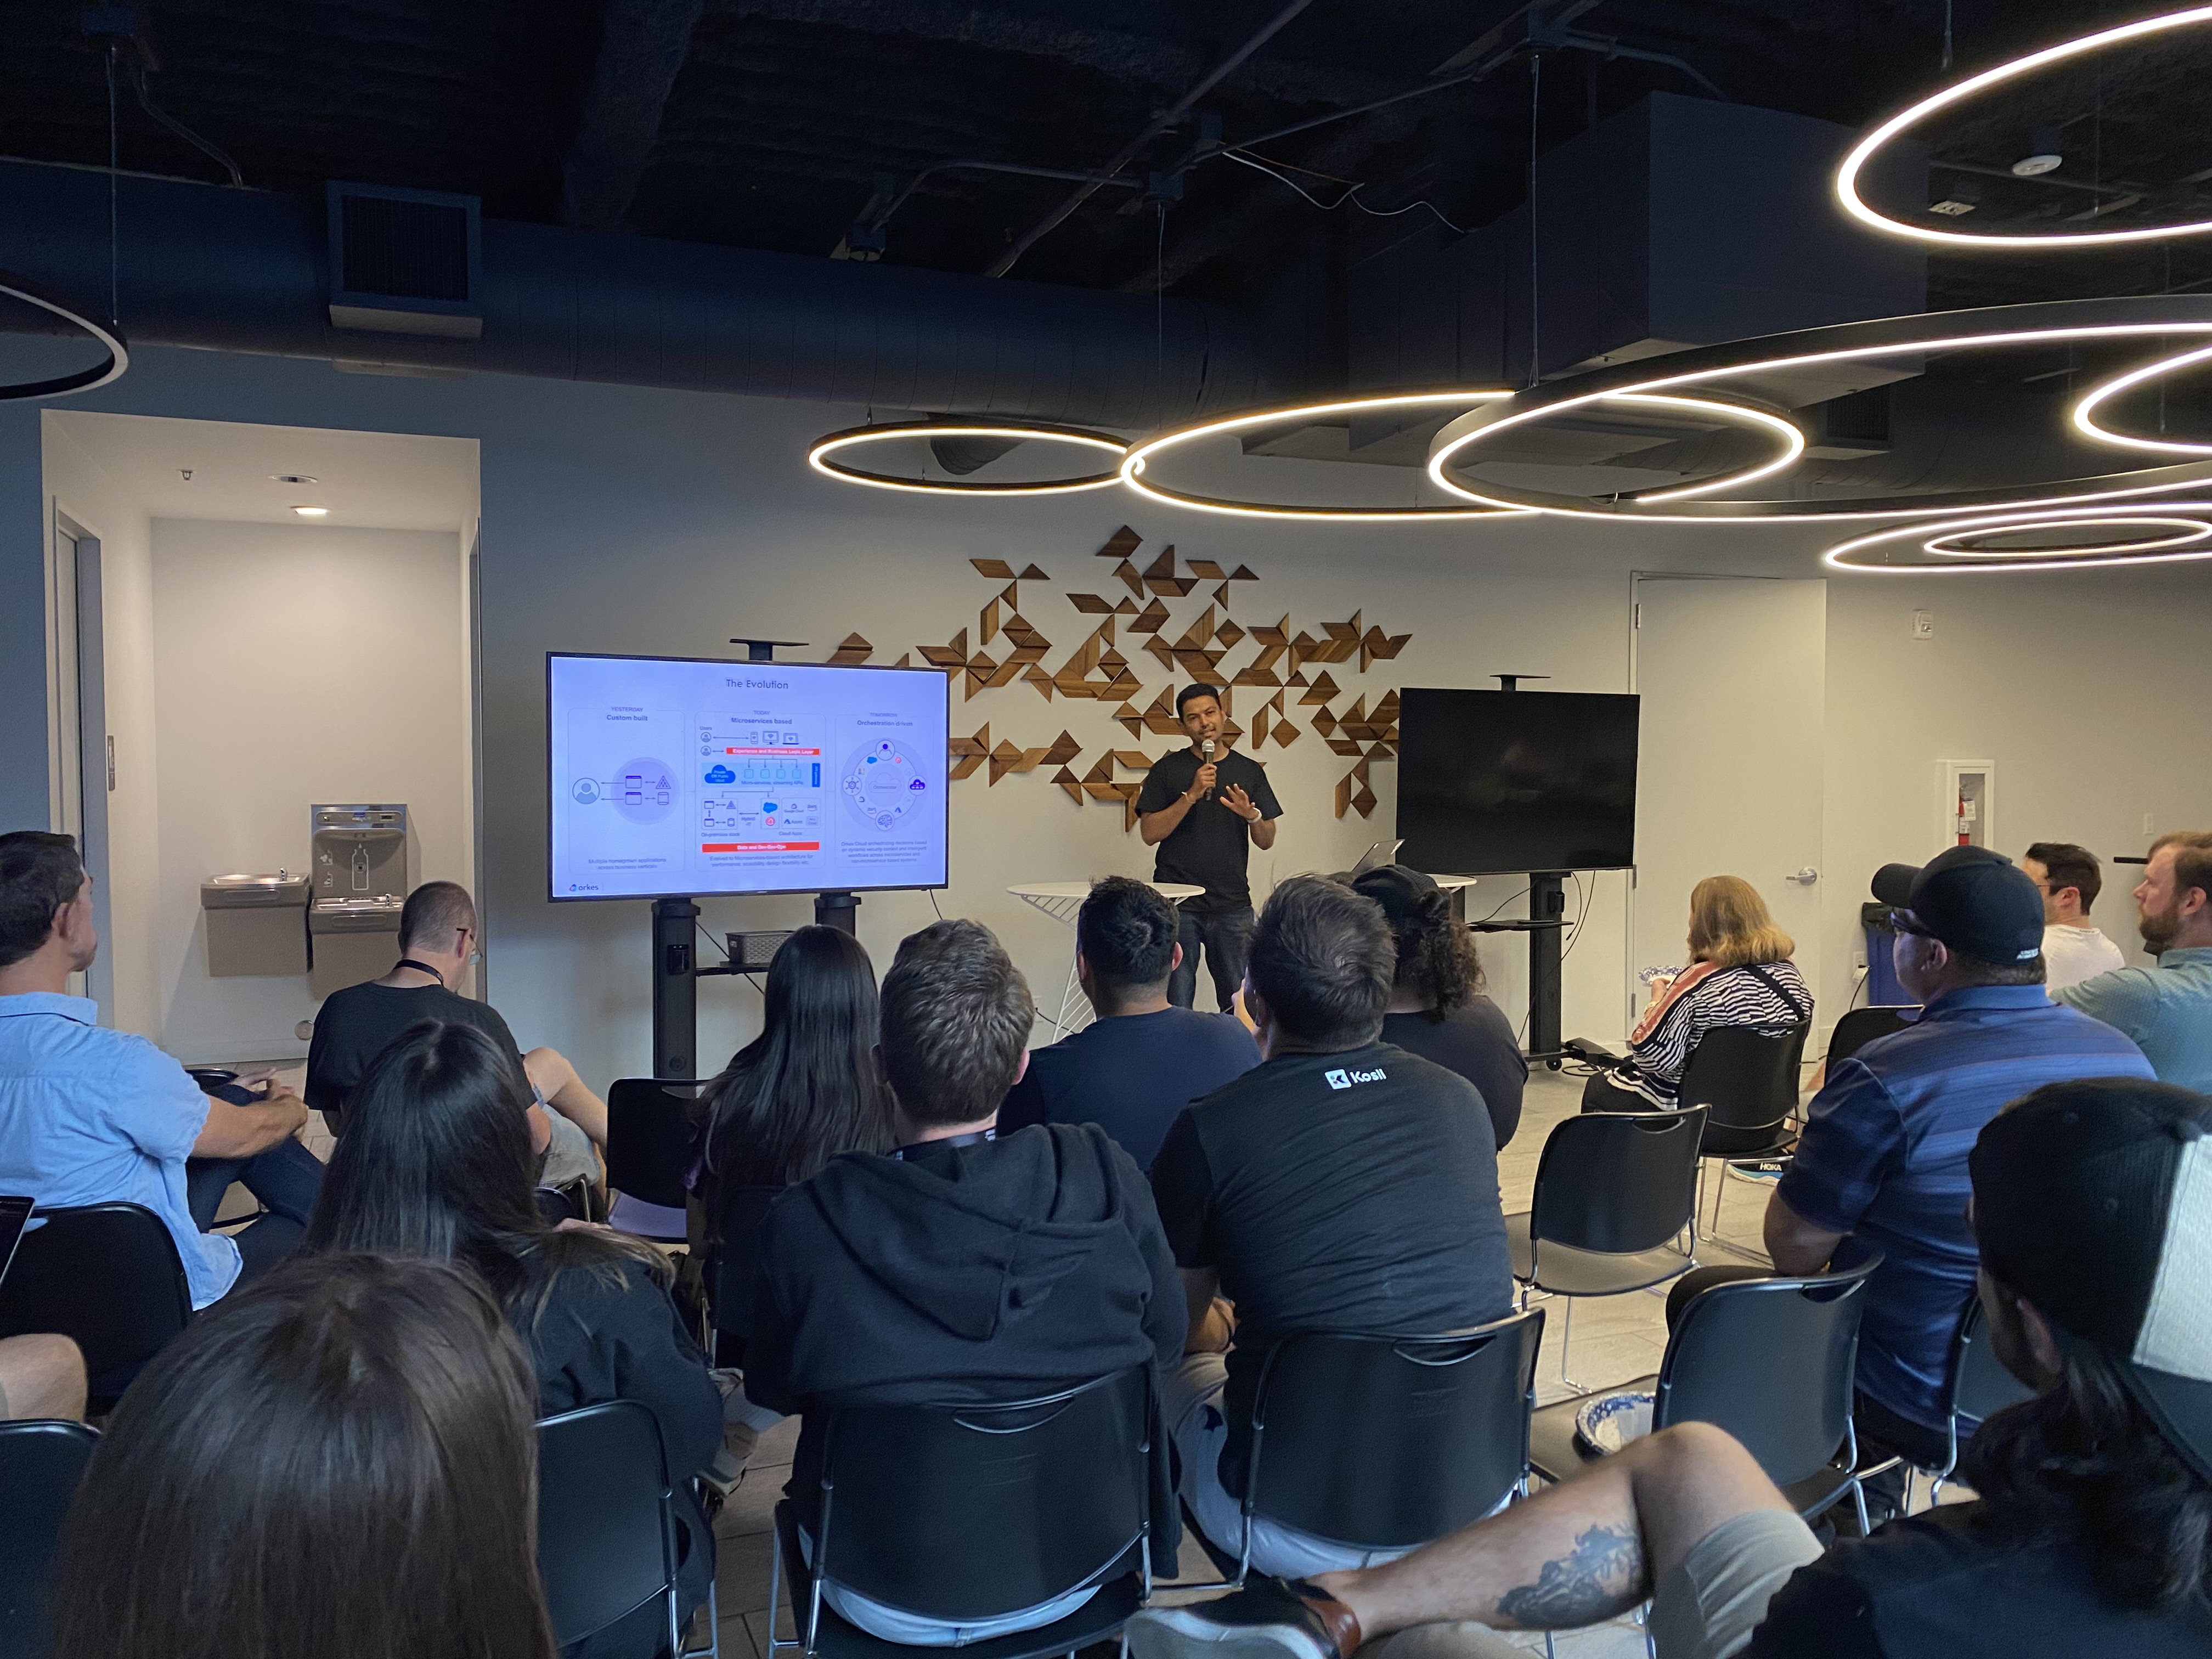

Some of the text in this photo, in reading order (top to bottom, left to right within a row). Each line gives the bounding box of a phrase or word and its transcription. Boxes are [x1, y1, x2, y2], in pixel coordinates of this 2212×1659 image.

[726, 679, 788, 689] The Evolution
[1759, 1162, 1782, 1171] HOKA
